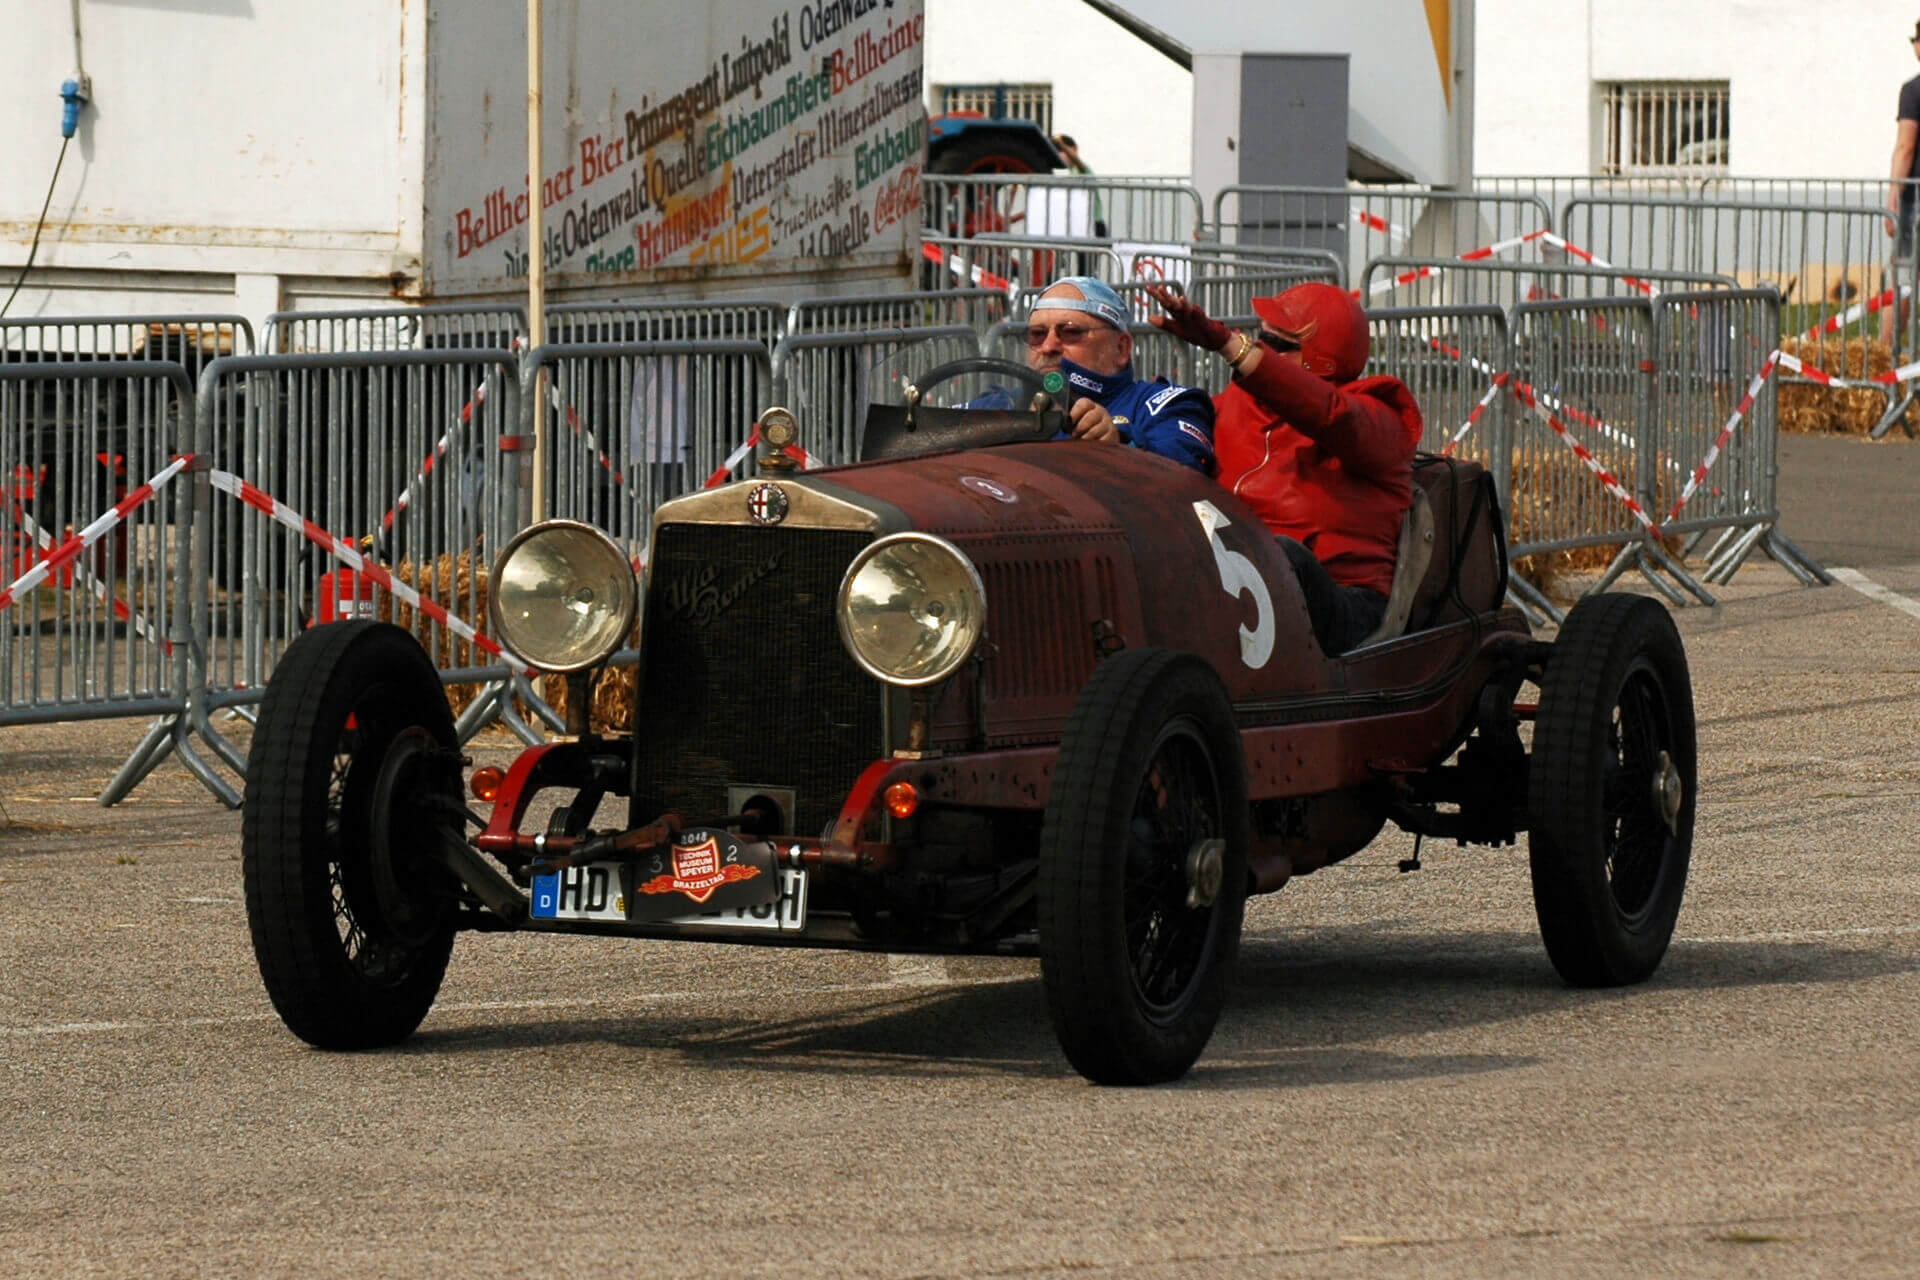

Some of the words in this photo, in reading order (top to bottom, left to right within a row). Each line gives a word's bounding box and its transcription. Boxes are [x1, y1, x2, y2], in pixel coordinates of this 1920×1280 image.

[580, 135, 624, 187] Bier
[722, 10, 792, 101] Luitpold
[562, 162, 650, 257] Odenwald
[652, 137, 706, 212] Quelle
[733, 131, 816, 226] Peterstaler
[819, 202, 870, 257] Quelle
[1192, 500, 1275, 669] 5
[679, 857, 713, 868] MUSEUM
[680, 865, 714, 877] SPEYER
[727, 845, 737, 862] 2
[540, 894, 551, 908] D
[559, 866, 609, 912] HD
